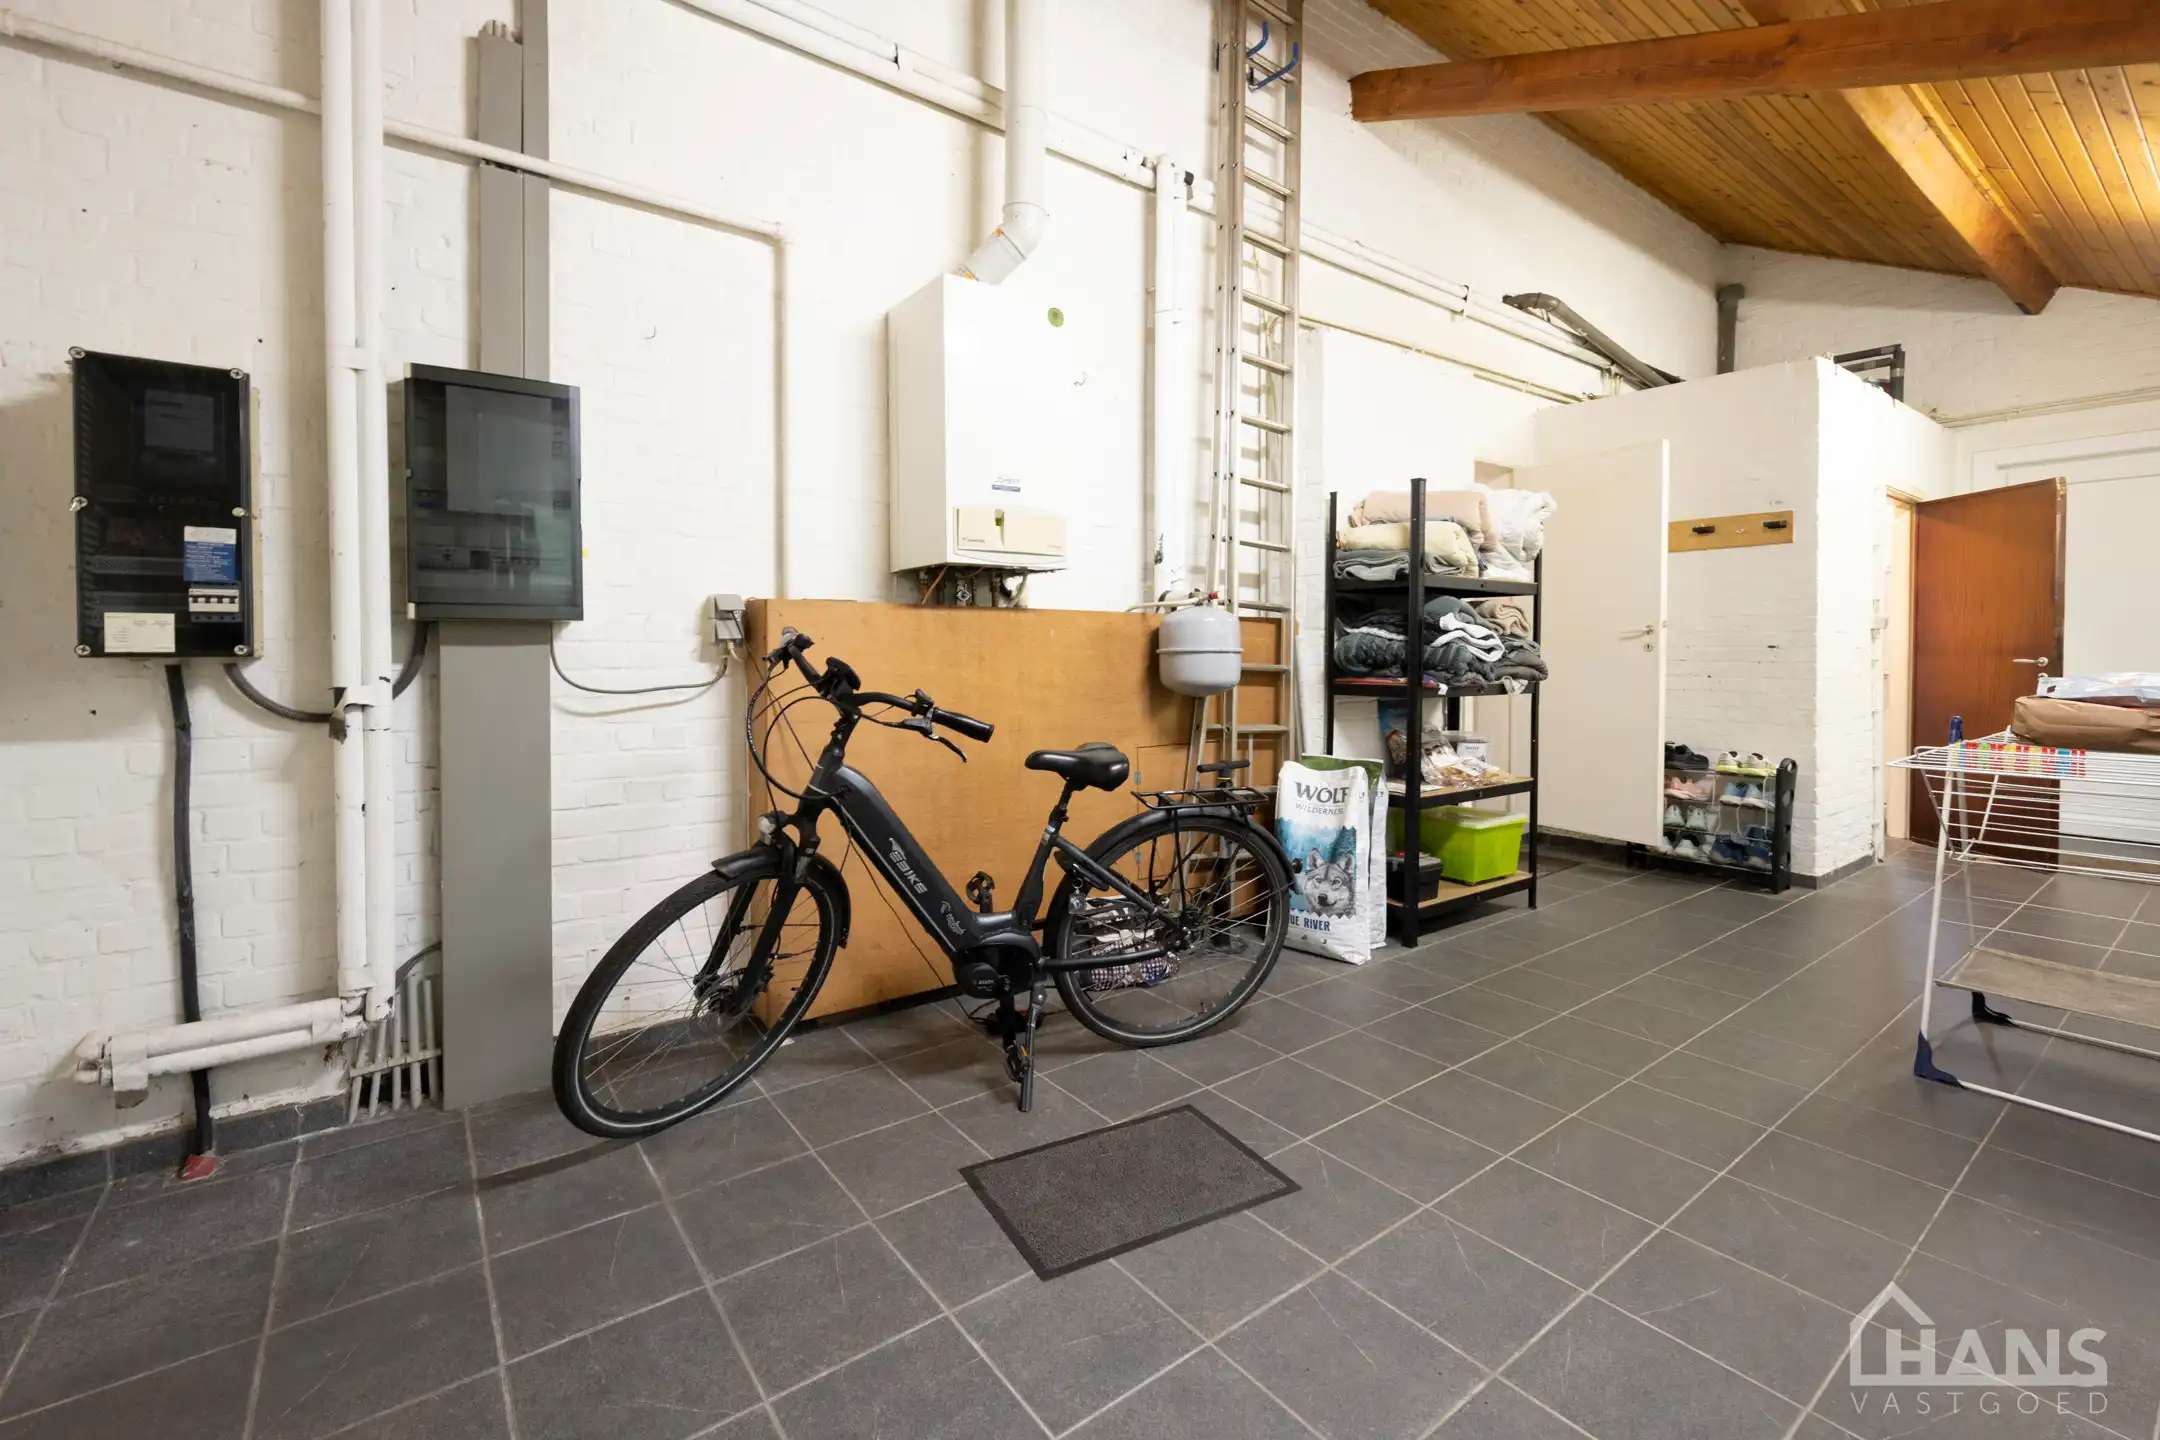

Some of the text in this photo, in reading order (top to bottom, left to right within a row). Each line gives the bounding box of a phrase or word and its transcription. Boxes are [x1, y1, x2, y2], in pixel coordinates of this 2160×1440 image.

[1294, 781, 1350, 804] WOLF
[889, 851, 928, 894] EBIKE
[1290, 915, 1330, 932] UE RIVER
